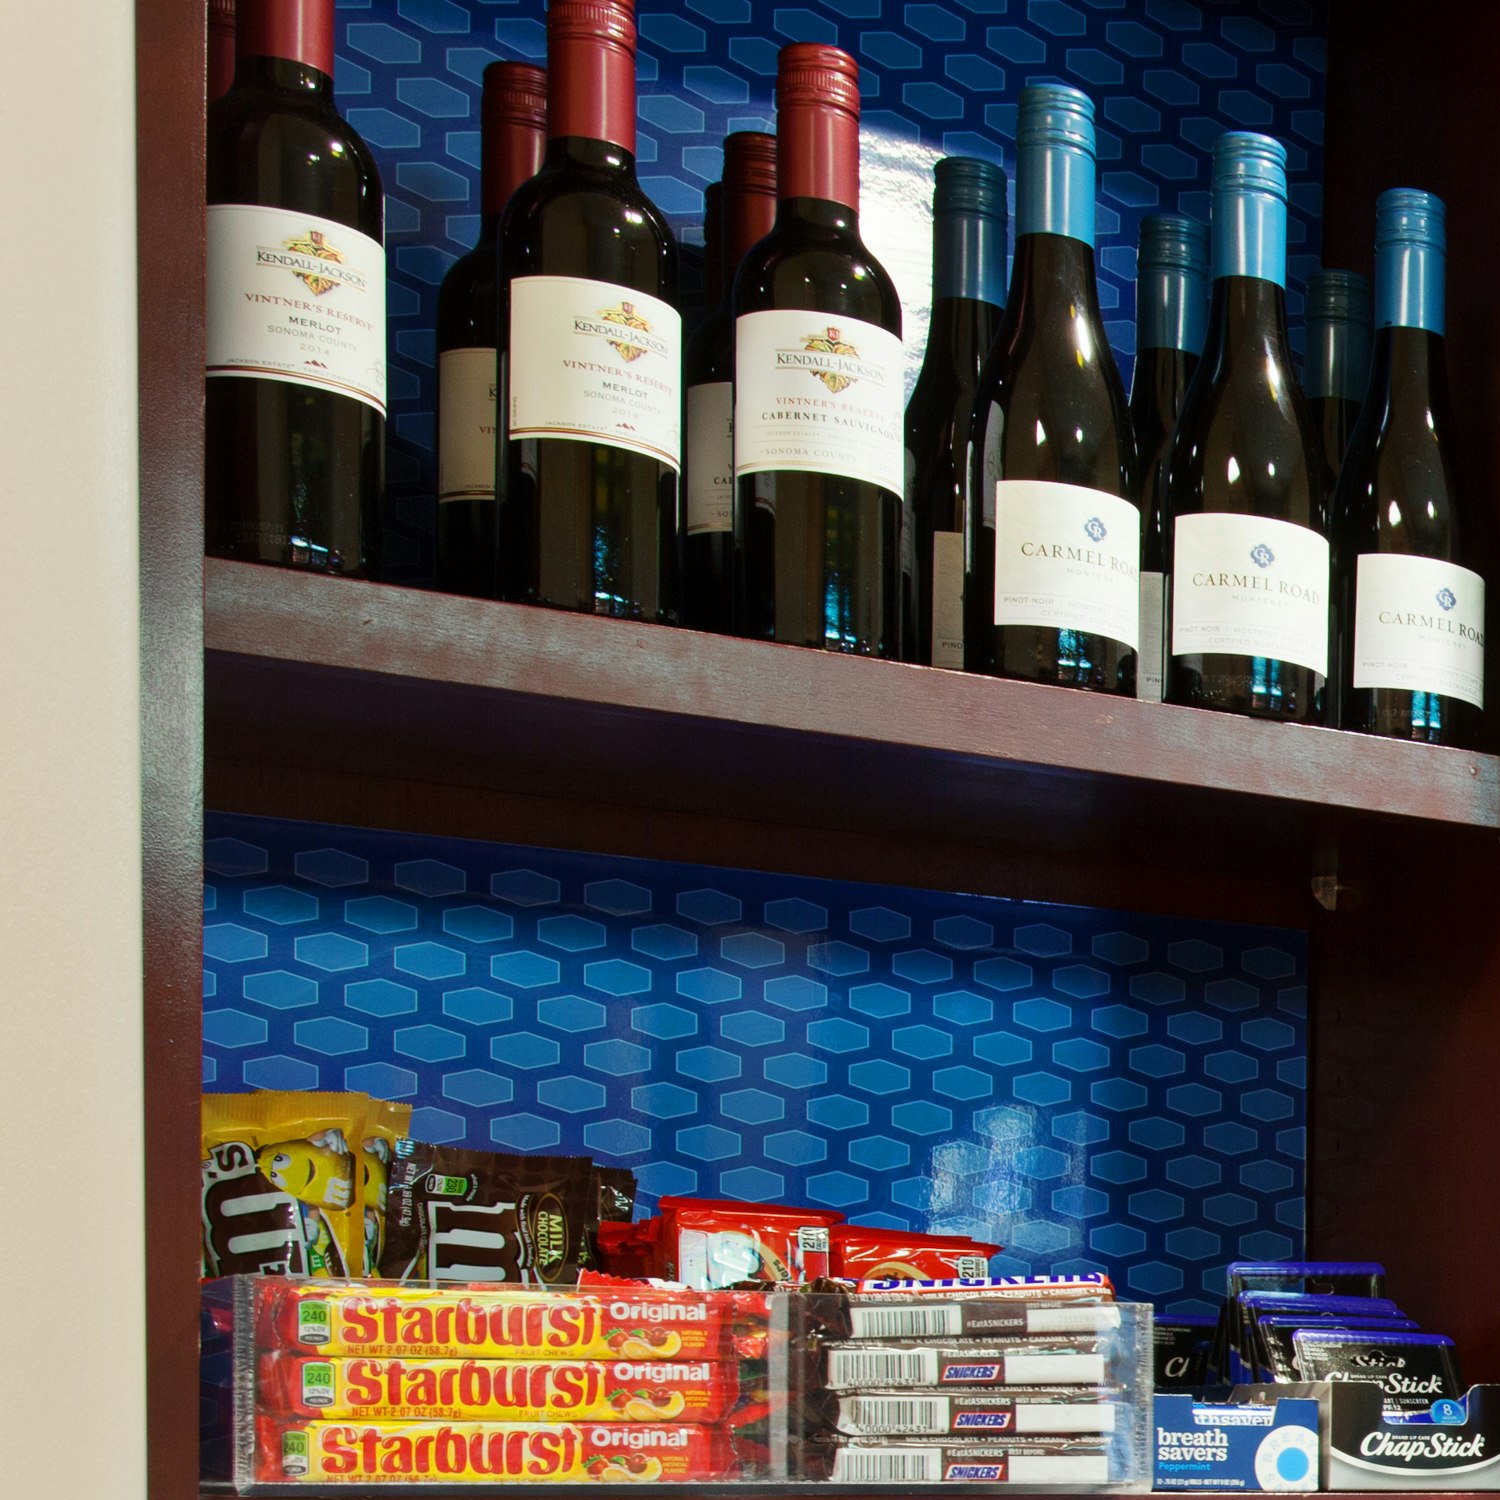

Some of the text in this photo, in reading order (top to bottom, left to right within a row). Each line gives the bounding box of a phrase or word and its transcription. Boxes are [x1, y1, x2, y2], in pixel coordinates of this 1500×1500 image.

[257, 251, 366, 287] KENDALL-JACKSON
[245, 293, 374, 331] VINTNER'S RESERVE
[289, 316, 342, 335] MERLOT
[268, 325, 358, 352] SONOMA COUNTY
[777, 353, 885, 380] KENDALL-JACKSON
[762, 412, 827, 422] CABERNET
[1021, 541, 1107, 567] CARMEL
[1193, 572, 1320, 606] CARMEL ROAD
[536, 1211, 549, 1267] CHOCOLATE
[547, 1214, 565, 1265] MILK
[342, 1298, 708, 1347] Starburst Original
[346, 1359, 710, 1407] Starburst Original
[944, 1365, 1000, 1380] SNICKERS
[955, 1413, 1011, 1427] SNICKERS
[321, 1425, 690, 1475] Starburst Original
[1158, 1427, 1229, 1447] breath
[1360, 1431, 1481, 1461] ChapStick
[1158, 1444, 1228, 1462] savers
[1159, 1461, 1211, 1472] Peppermint
